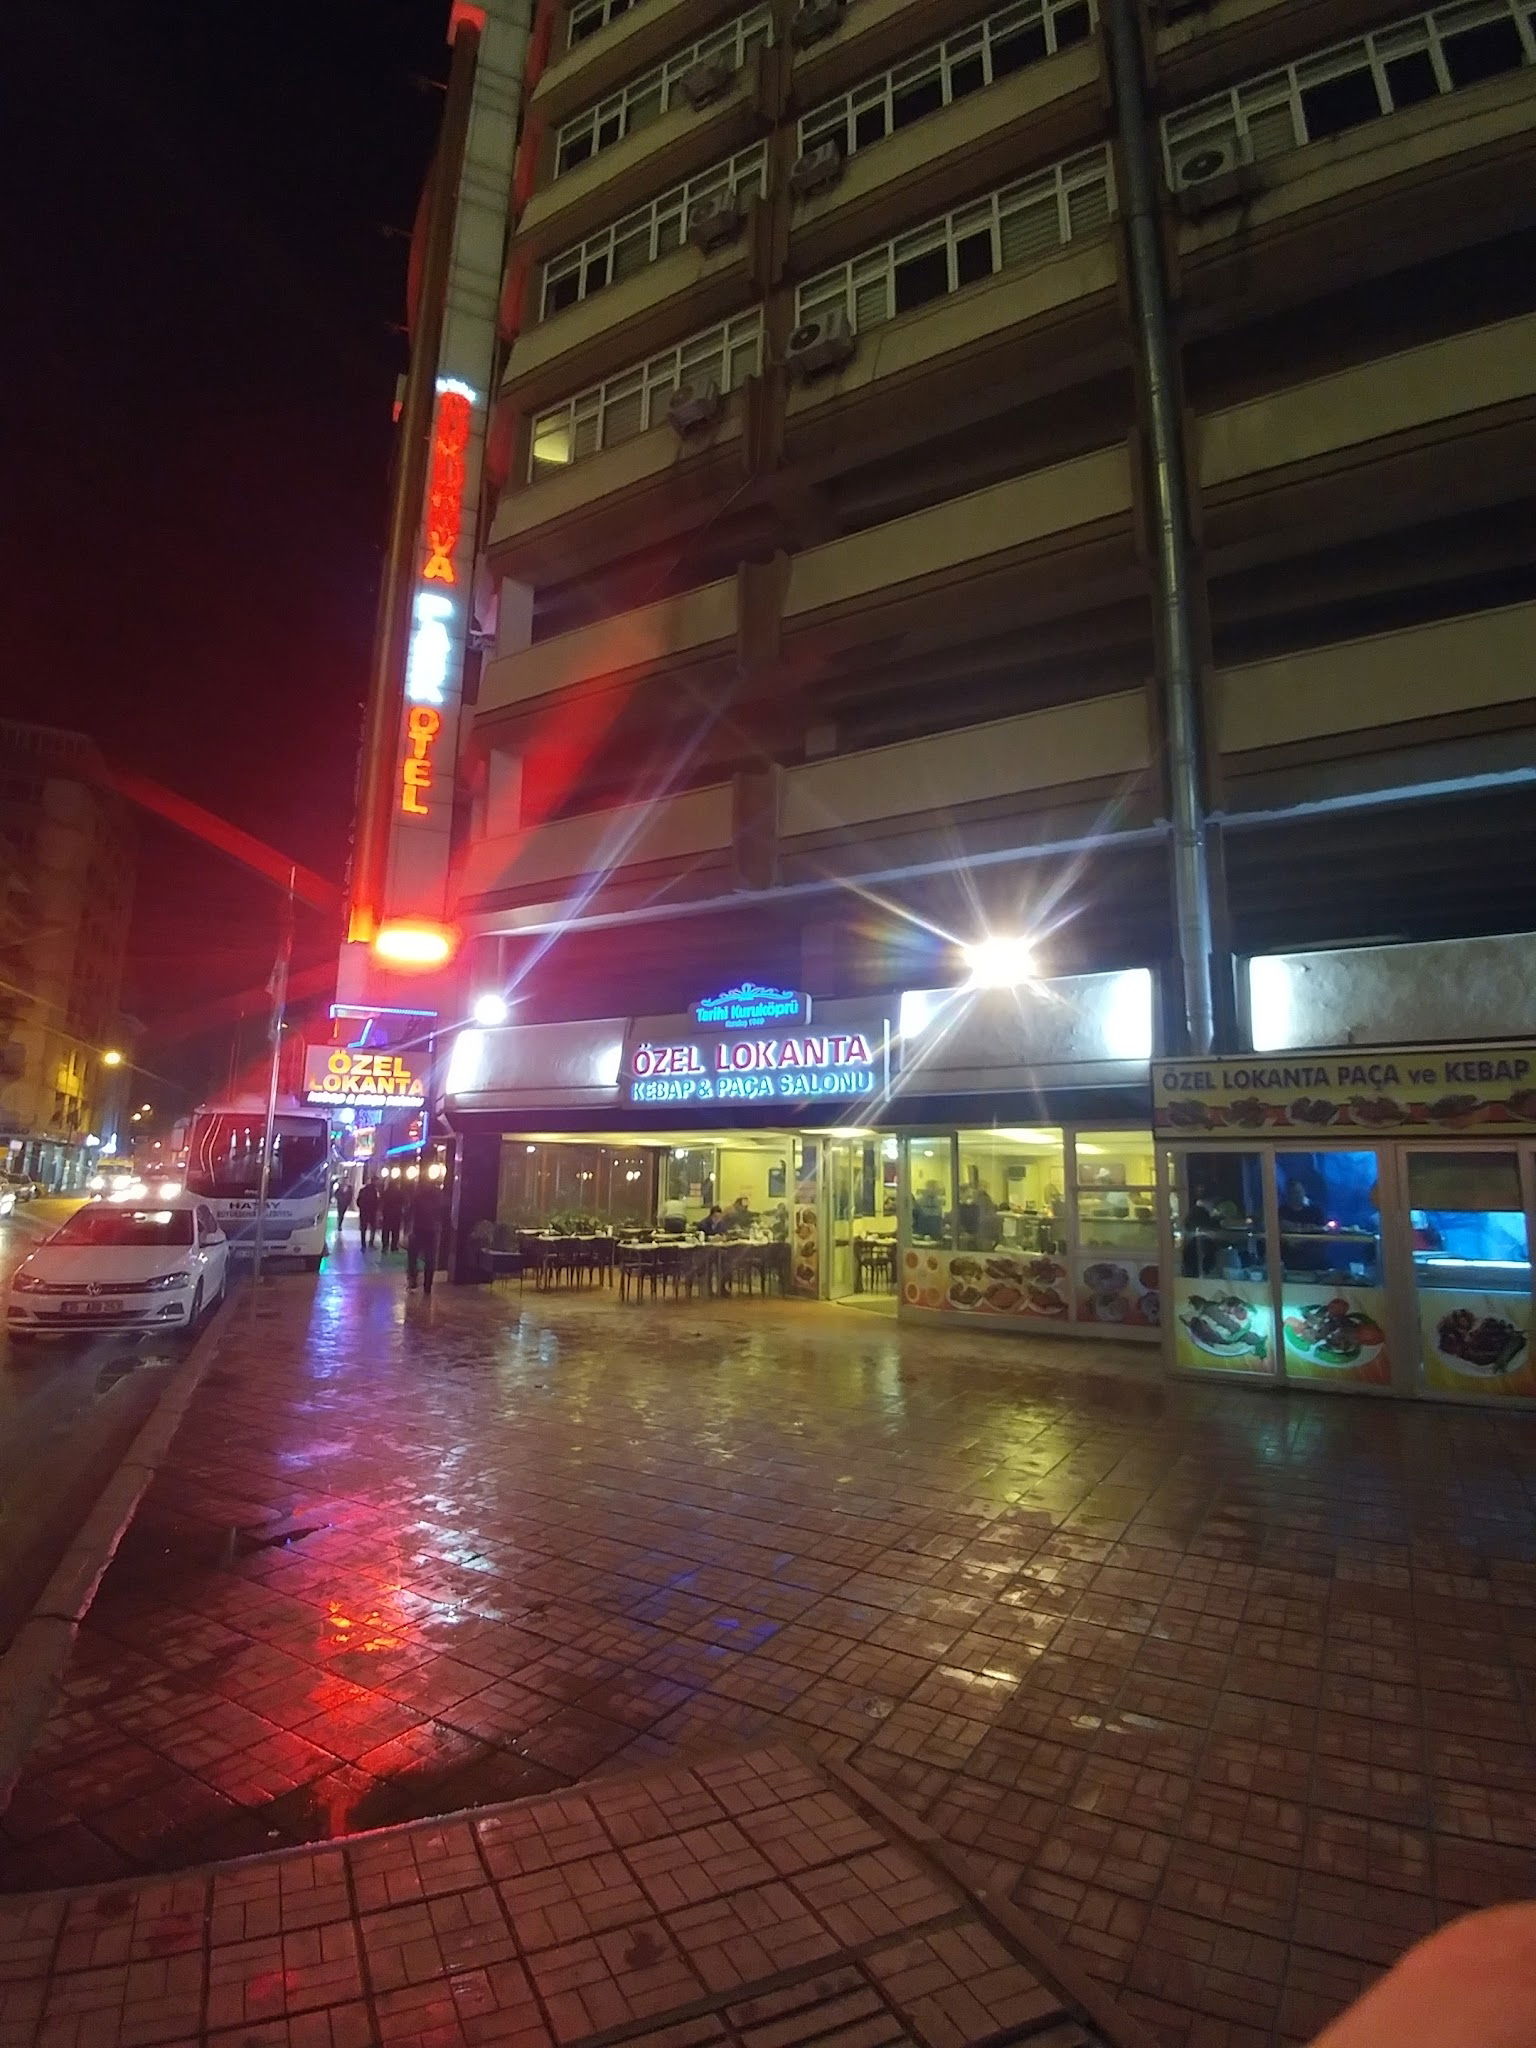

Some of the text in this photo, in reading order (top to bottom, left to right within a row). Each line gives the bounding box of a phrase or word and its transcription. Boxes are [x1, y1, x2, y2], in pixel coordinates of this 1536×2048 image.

[402, 706, 440, 816] OTEL
[696, 1000, 799, 1022] Tarihi Kuruköprü
[327, 1050, 411, 1078] ÖZEL
[632, 1034, 873, 1076] ÖZEL LOKANTA
[309, 1074, 424, 1095] LOKANTA
[633, 1071, 874, 1100] KEBAP & PAÇA SALONU
[1162, 1059, 1530, 1091] ÖZEL LOKANTA PAÇA ve KEBAP
